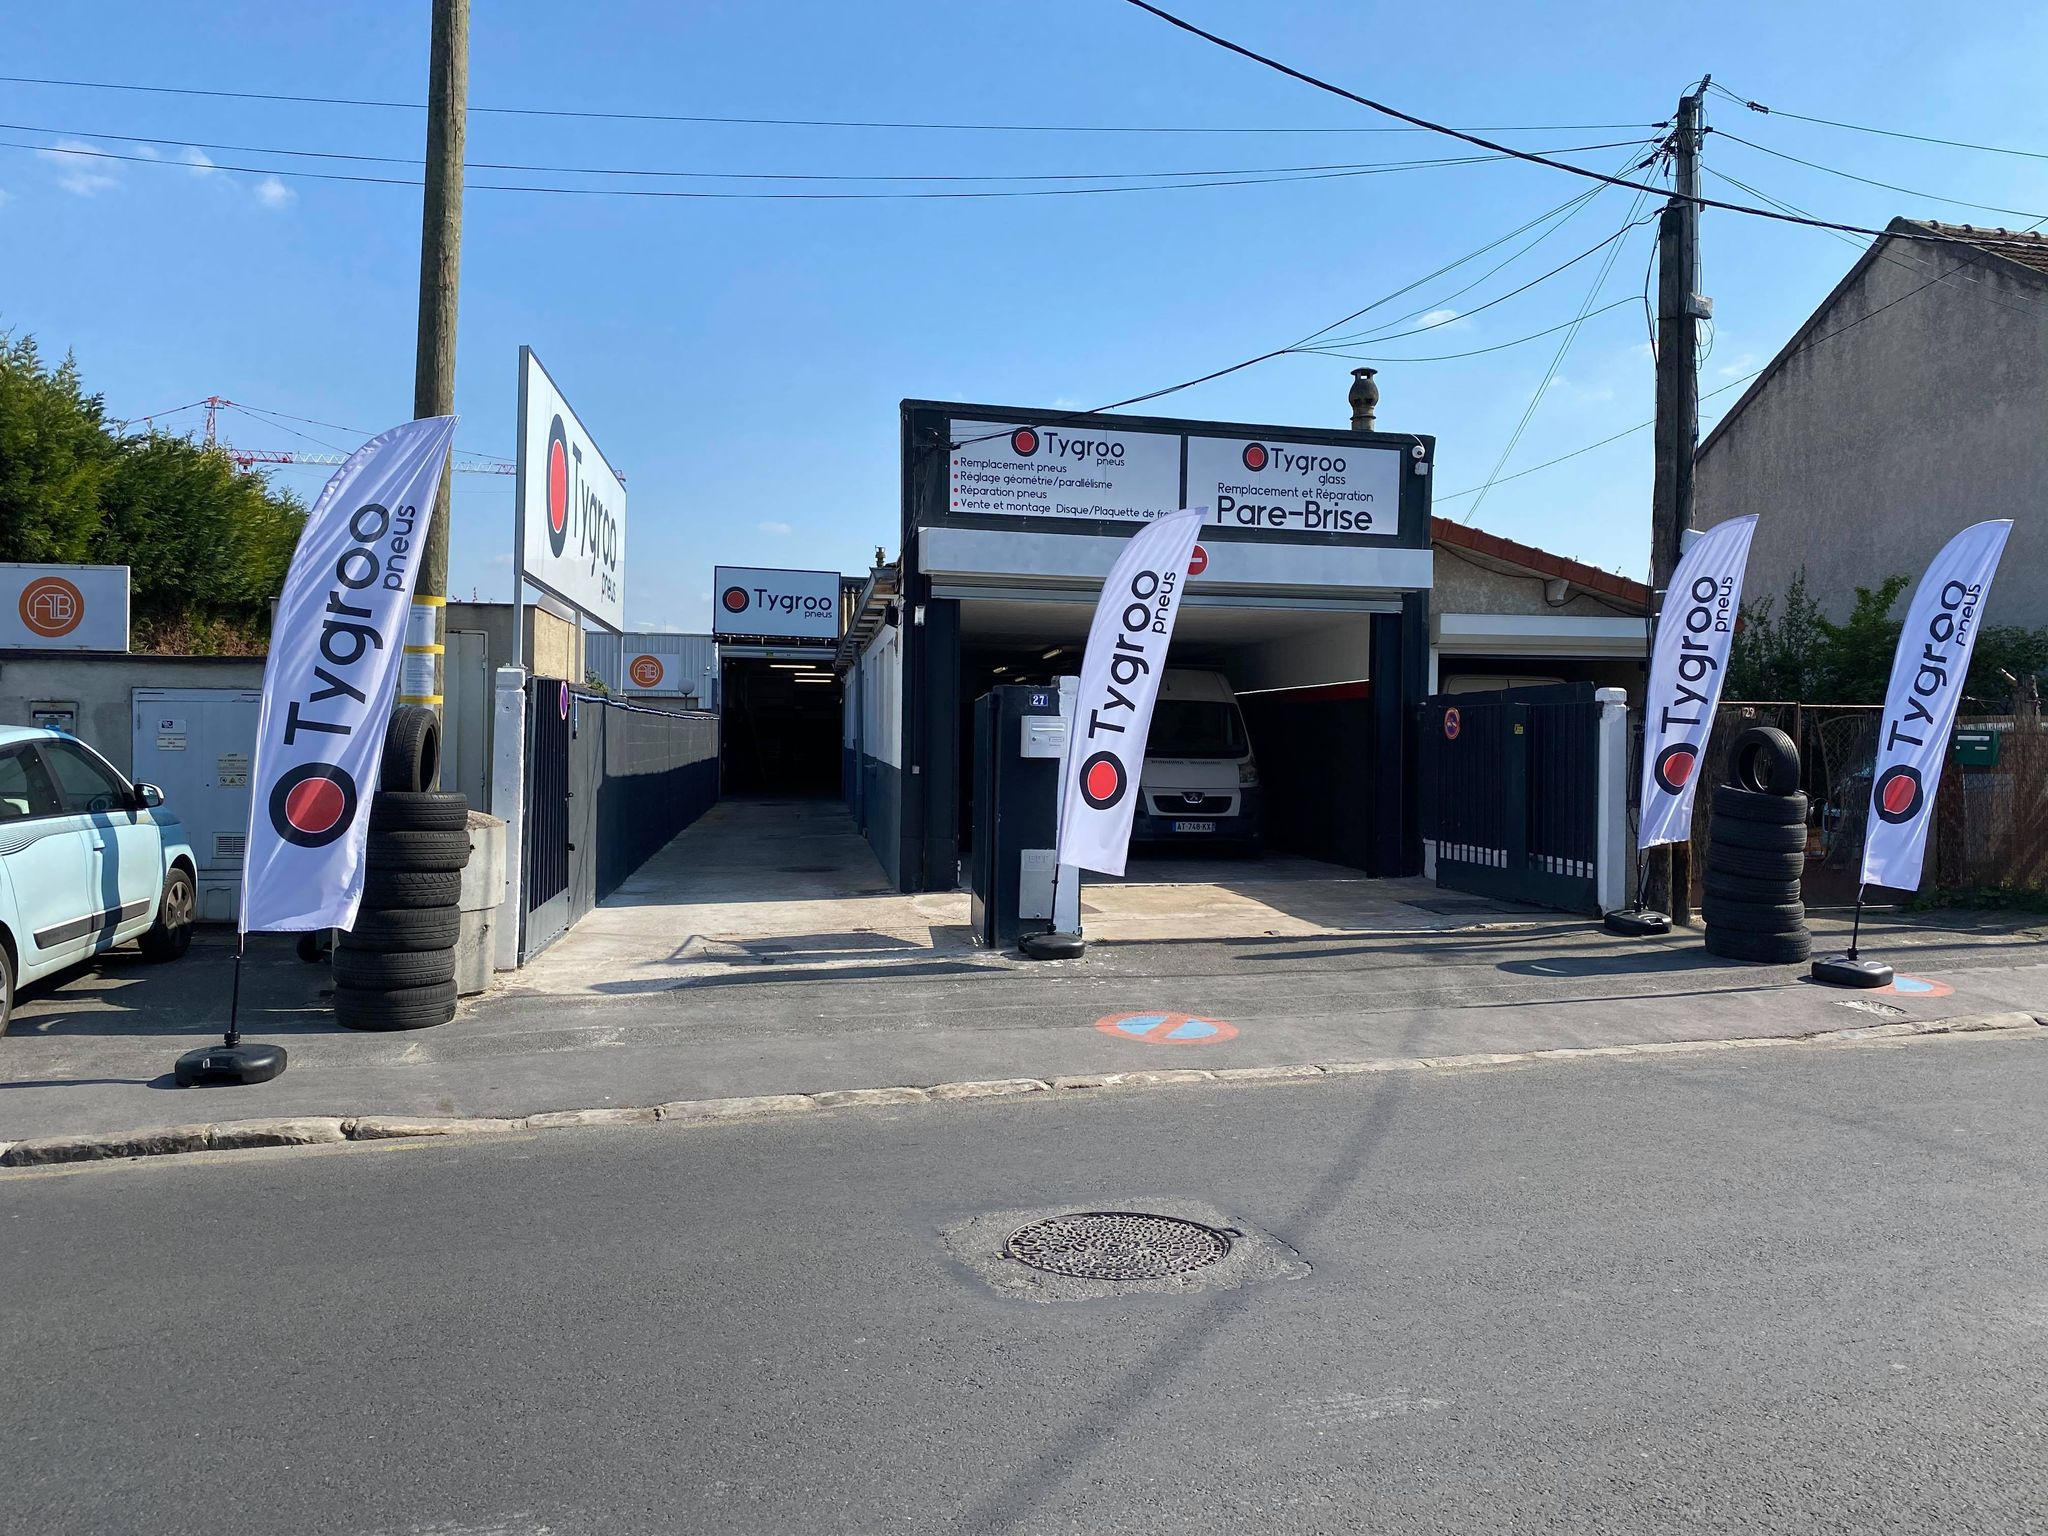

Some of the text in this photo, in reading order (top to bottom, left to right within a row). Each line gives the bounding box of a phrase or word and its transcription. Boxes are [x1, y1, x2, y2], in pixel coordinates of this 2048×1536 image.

[1043, 432, 1125, 461] Tygroo
[960, 457, 1067, 474] Remplacement pneus
[1096, 458, 1125, 467] pneus
[1270, 447, 1347, 476] Tygroo
[960, 471, 1113, 490] Réglage géométrie/parallélisme
[960, 485, 1047, 499] Réparation pneus
[1218, 482, 1374, 502] Remplacement et Réparation
[1318, 473, 1346, 486] glass
[572, 441, 617, 577] Tygroo
[960, 499, 991, 510] Vente
[993, 501, 1004, 510] et
[1006, 502, 1051, 513] montage
[1056, 503, 1140, 518] Disque/Plaquette
[1142, 508, 1154, 518] de
[1217, 495, 1373, 531] Pare-Brise
[382, 504, 416, 592] pneus
[601, 571, 616, 603] pneus
[754, 588, 832, 614] Tygroo
[1151, 571, 1176, 635] pneus
[1714, 576, 1733, 633] pneus
[1955, 584, 1981, 646] pneus
[283, 503, 390, 745] Tygroo
[1088, 570, 1160, 739] Tygroo
[1660, 576, 1718, 734] Tygroo
[1886, 580, 1967, 751] Tygroo
[1032, 695, 1045, 705] 27
[1743, 707, 1755, 718] 29
